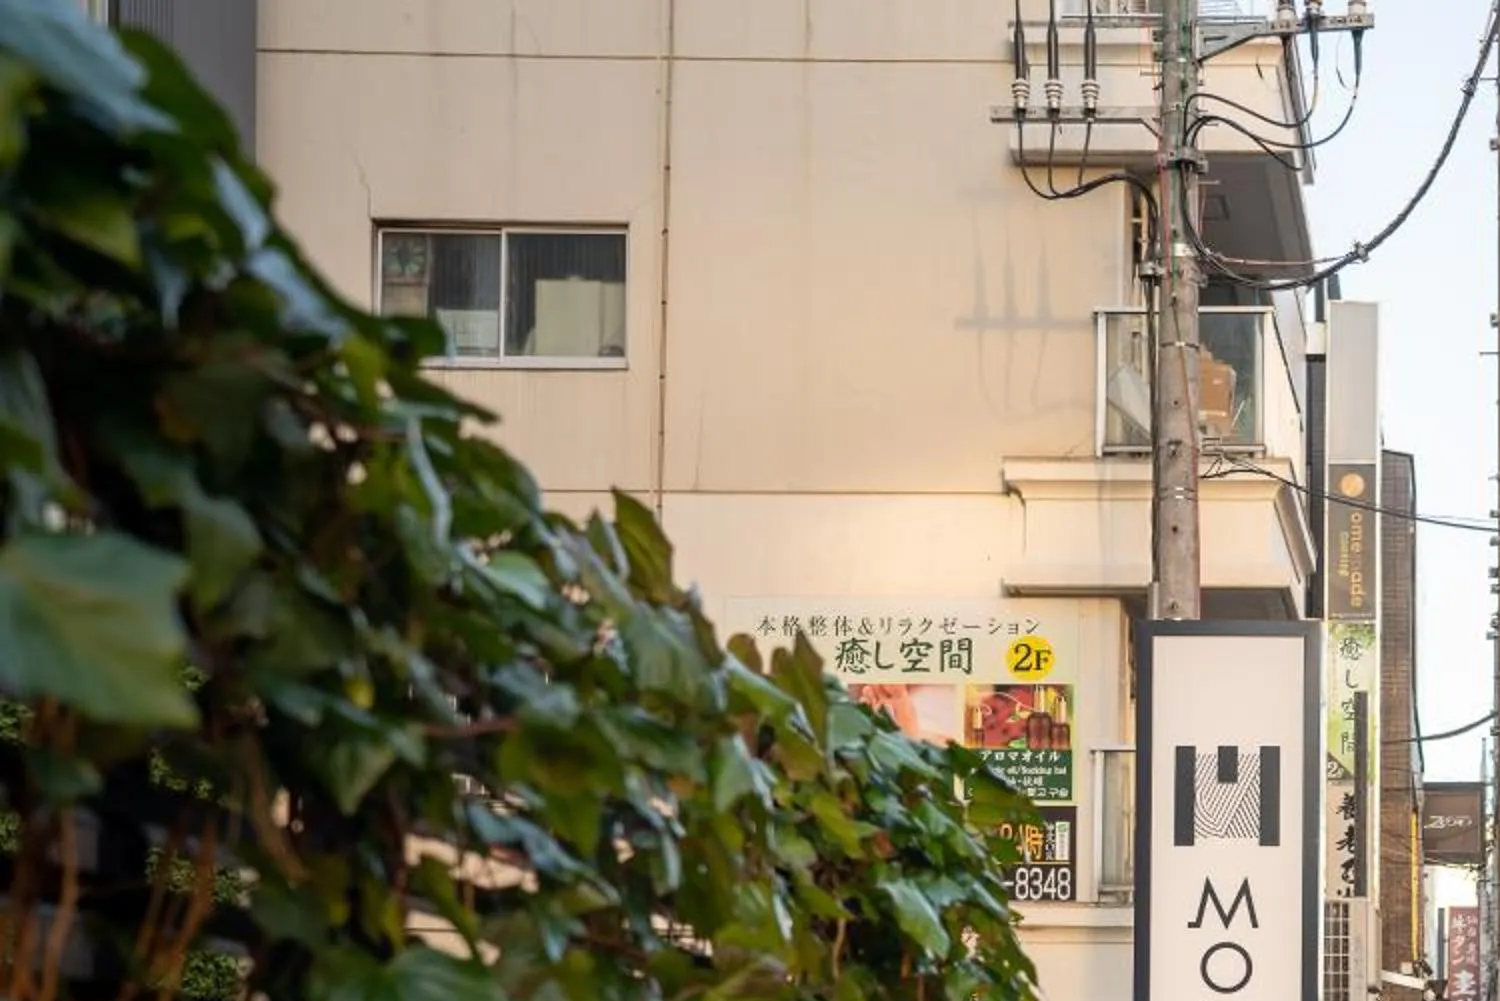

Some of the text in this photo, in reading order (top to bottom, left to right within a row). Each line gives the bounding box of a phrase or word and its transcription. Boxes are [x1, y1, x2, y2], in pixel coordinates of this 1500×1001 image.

[834, 637, 974, 675] 癒し空間
[1013, 643, 1053, 672] 2F
[980, 750, 1061, 762] アロマオイル
